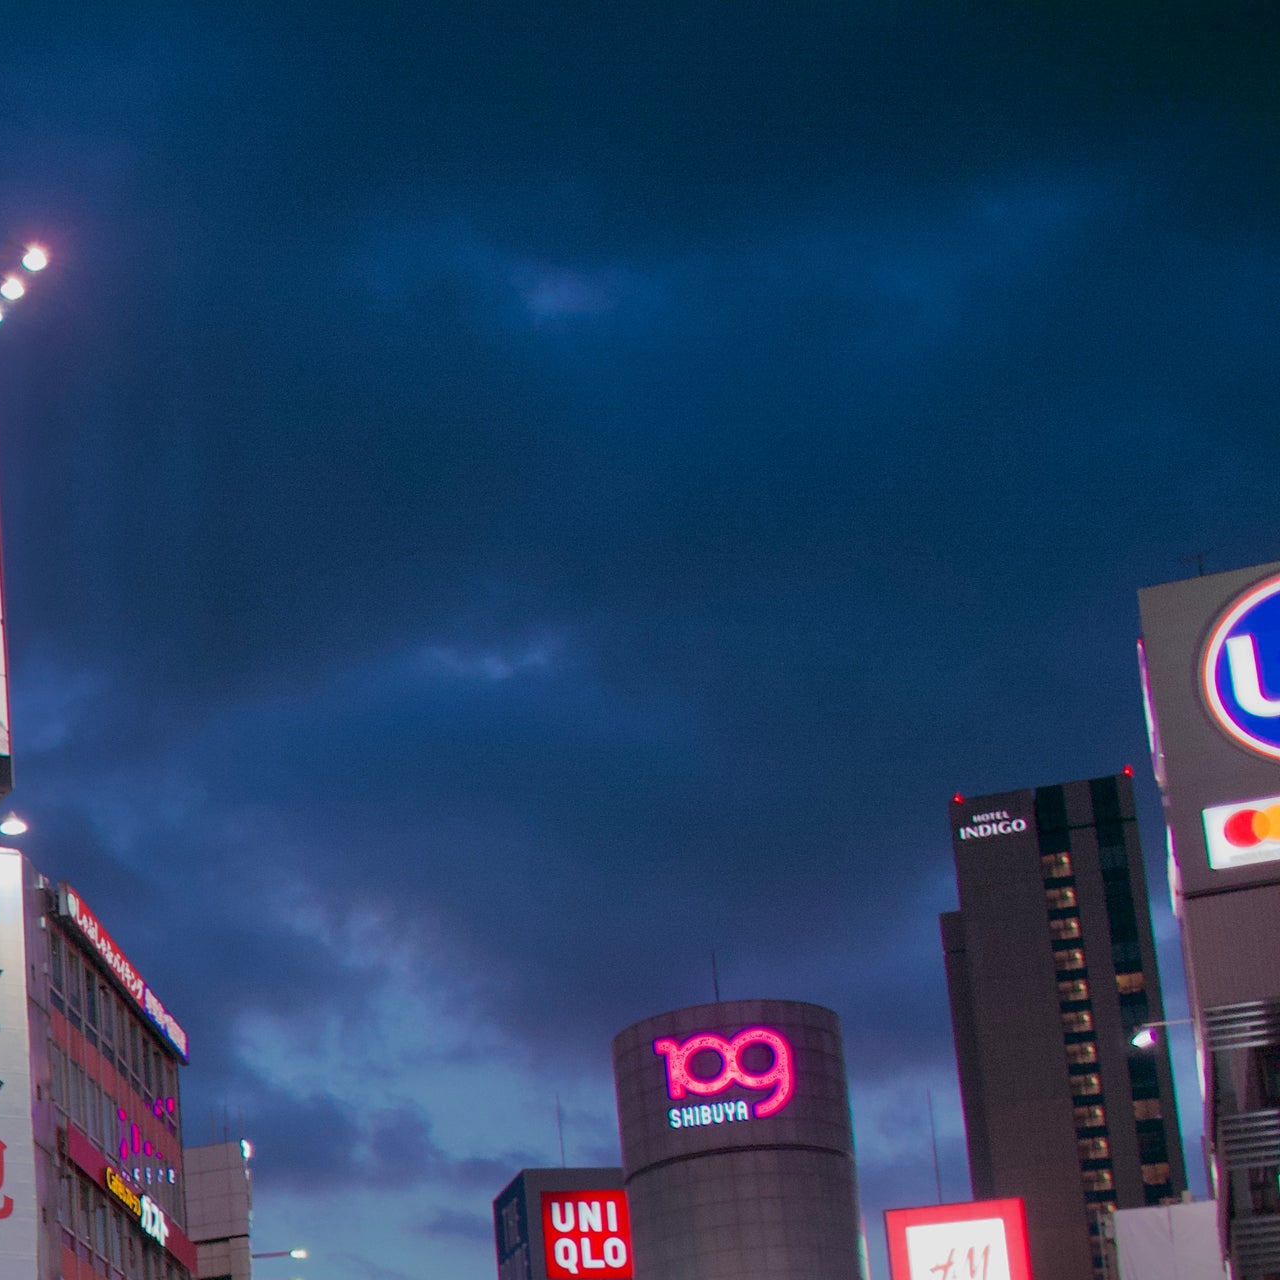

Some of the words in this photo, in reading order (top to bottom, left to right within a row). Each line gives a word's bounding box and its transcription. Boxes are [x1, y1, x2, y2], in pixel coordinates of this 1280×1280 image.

[960, 819, 1027, 840] INDIGO
[972, 810, 1009, 823] HOTEL
[654, 1026, 795, 1117] 109
[668, 1101, 748, 1129] SHIBUYA
[550, 1200, 619, 1232] UNI
[553, 1236, 628, 1273] QLO
